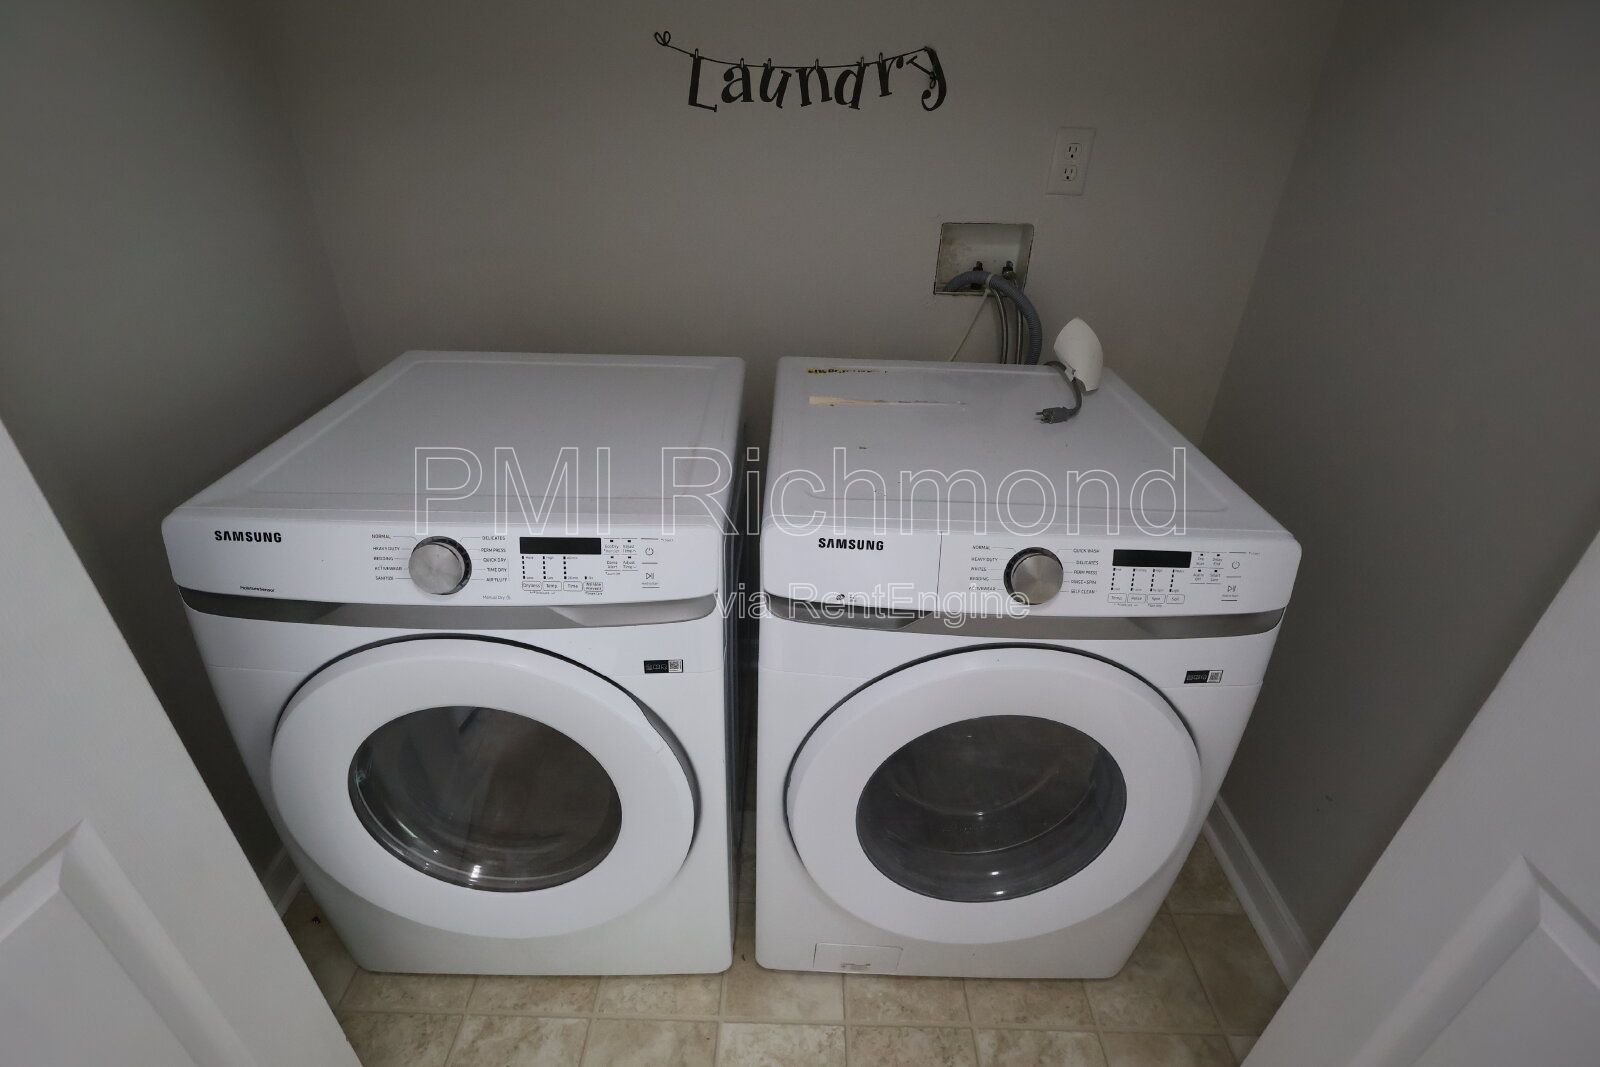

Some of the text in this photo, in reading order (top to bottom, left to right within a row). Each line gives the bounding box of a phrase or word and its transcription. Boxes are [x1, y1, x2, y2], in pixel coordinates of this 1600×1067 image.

[688, 46, 947, 112] Laundry
[214, 530, 282, 543] SAMSUNG
[818, 537, 884, 551] SAMSUNG
